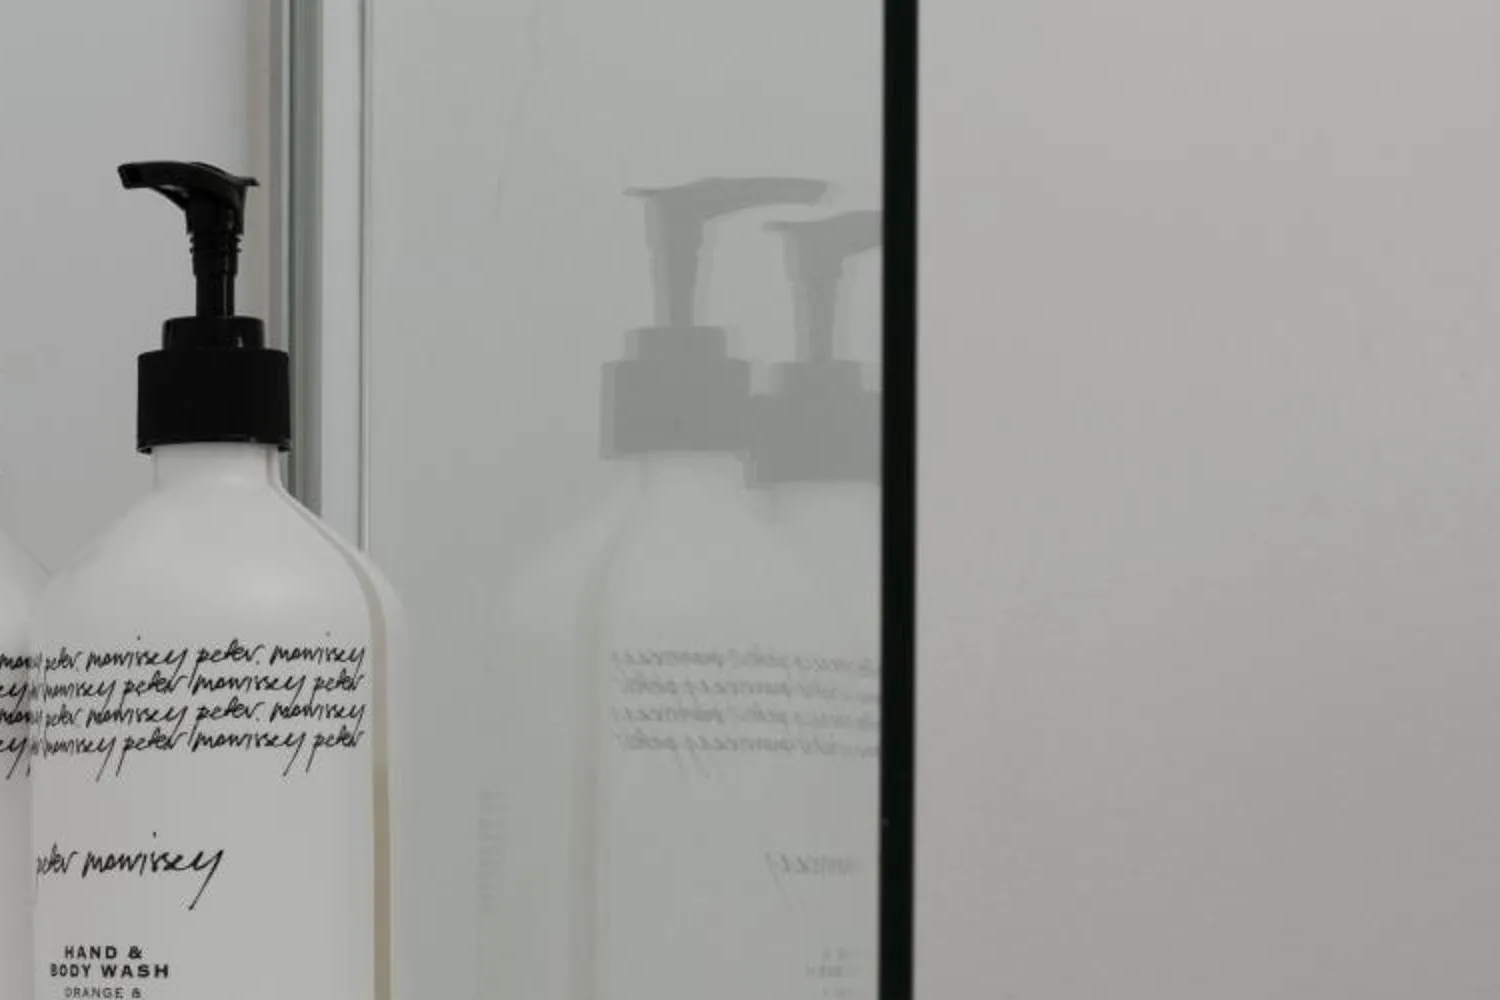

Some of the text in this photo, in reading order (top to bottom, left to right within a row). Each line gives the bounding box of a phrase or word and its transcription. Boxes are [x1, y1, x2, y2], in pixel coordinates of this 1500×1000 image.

[82, 831, 225, 911] morrissey
[64, 945, 142, 959] HAND &
[50, 963, 169, 978] BODY WASH
[64, 986, 142, 999] ORANGE &
